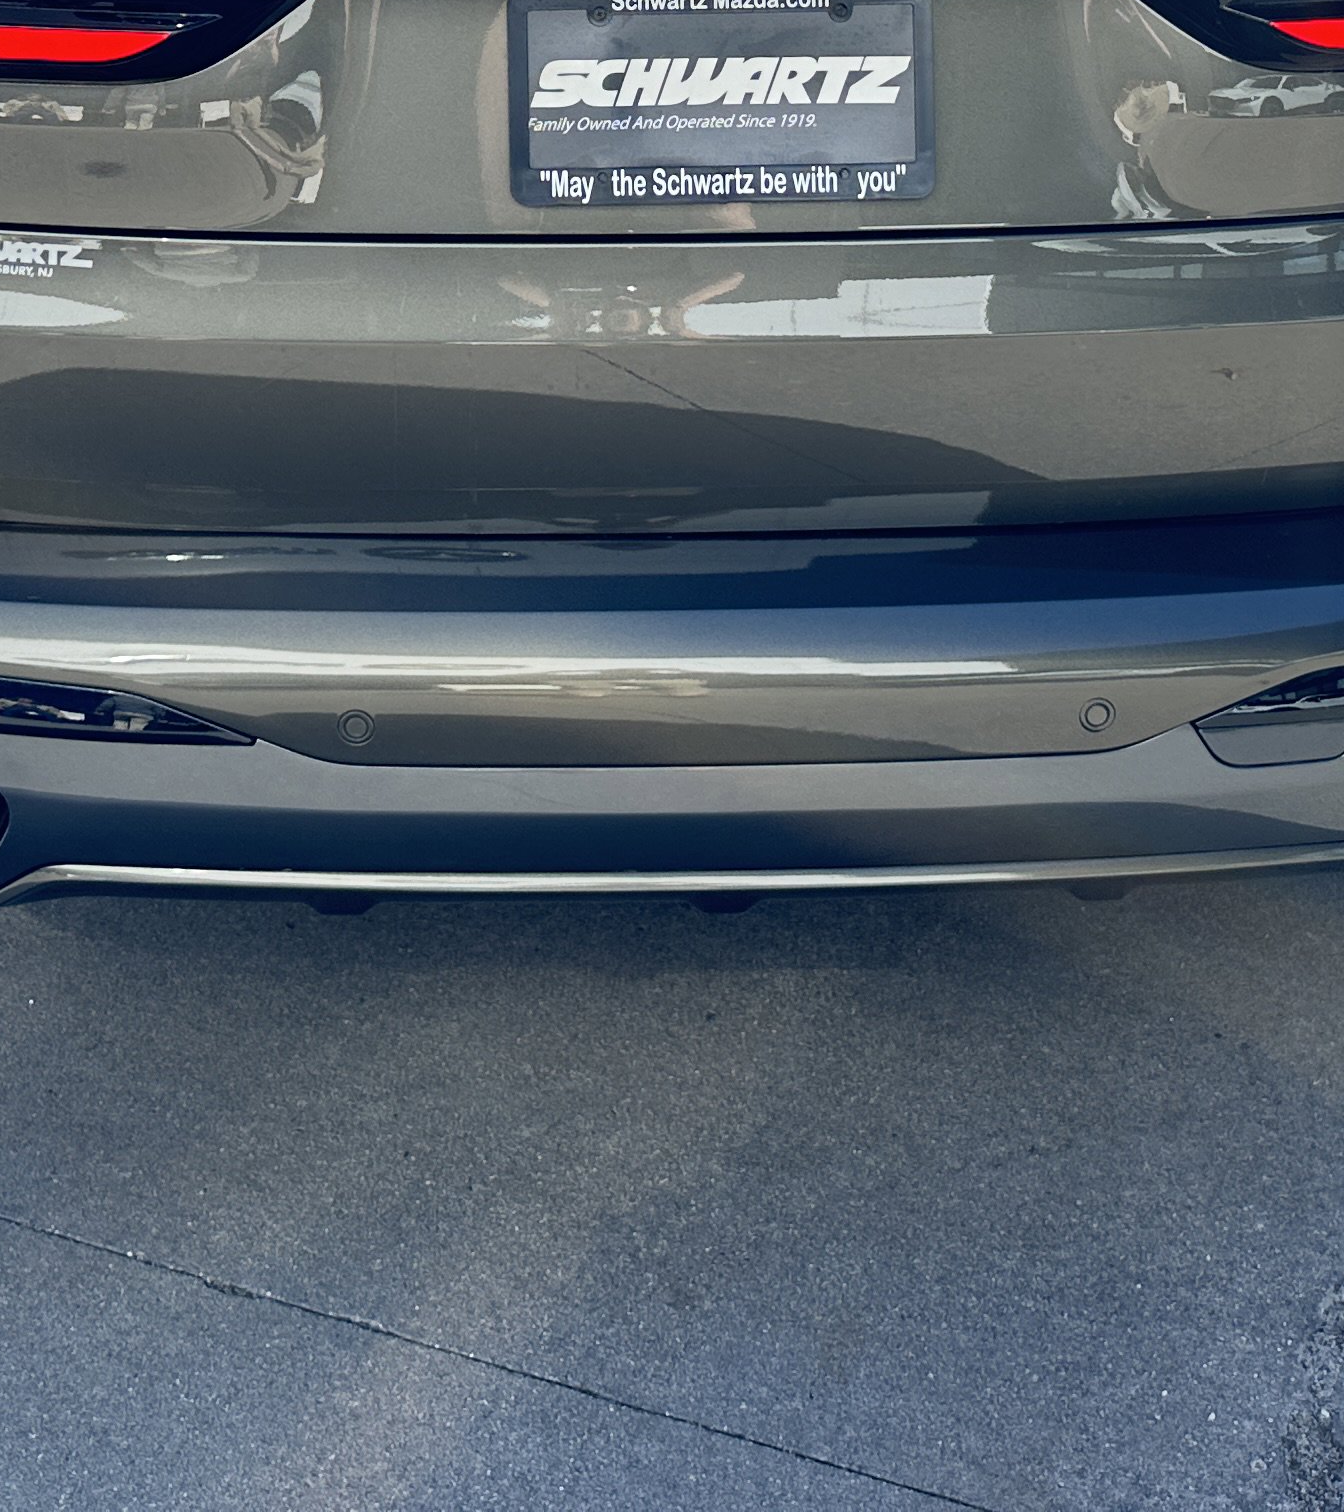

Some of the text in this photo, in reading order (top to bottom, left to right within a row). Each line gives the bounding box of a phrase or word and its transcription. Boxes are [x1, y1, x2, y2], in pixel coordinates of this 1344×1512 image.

[530, 55, 912, 108] SCHWARTZ
[528, 114, 817, 134] Family Owned And Operated Since 1919.
[539, 164, 907, 204] "May the Schwartz be with you"
[38, 267, 54, 278] NJ
